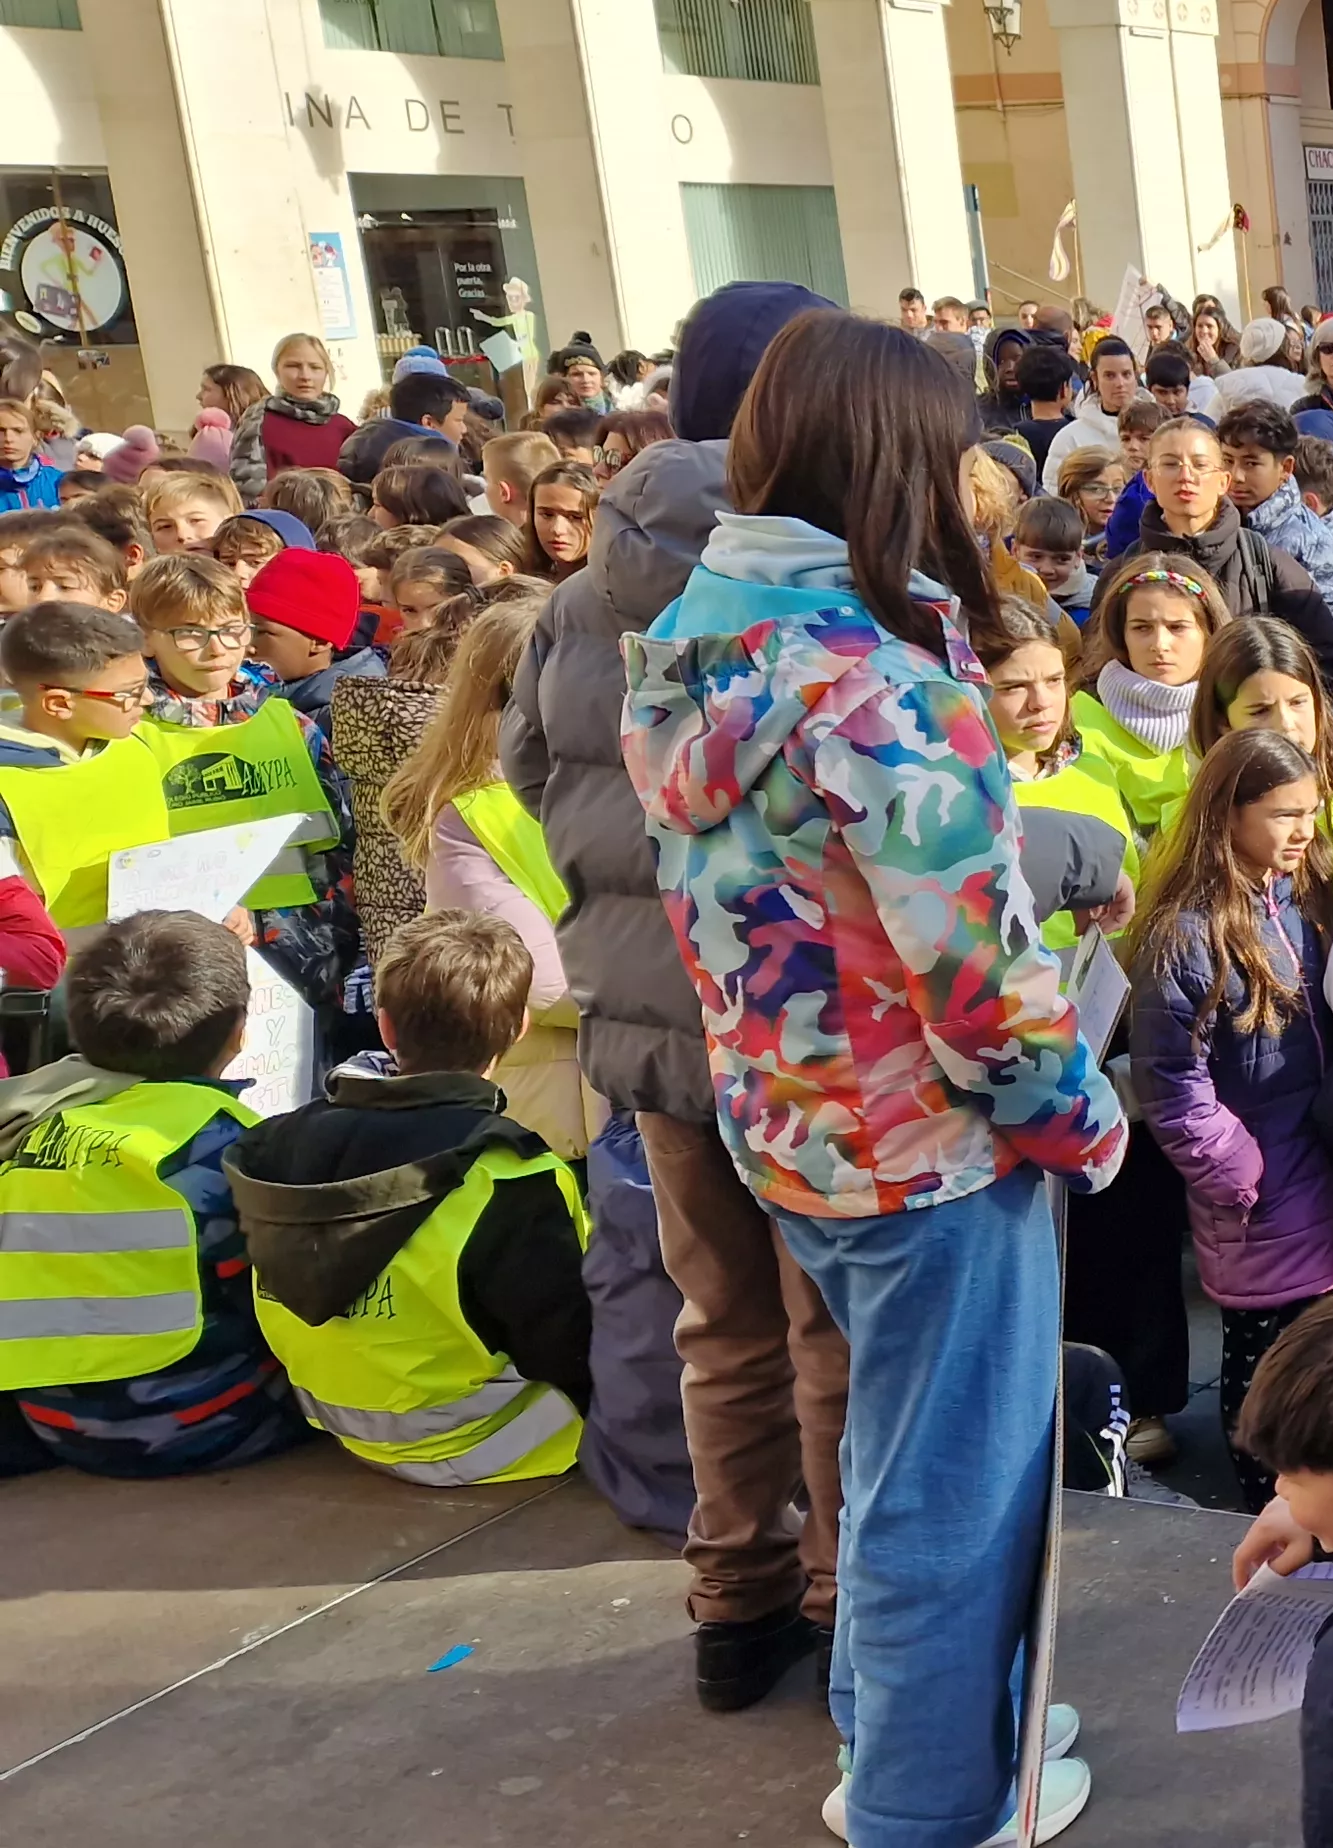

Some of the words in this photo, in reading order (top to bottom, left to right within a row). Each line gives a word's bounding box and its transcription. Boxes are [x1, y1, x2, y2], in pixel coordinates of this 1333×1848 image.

[405, 99, 464, 134] DE
[72, 209, 86, 223] A
[454, 262, 467, 273] Por
[475, 262, 493, 273] otra
